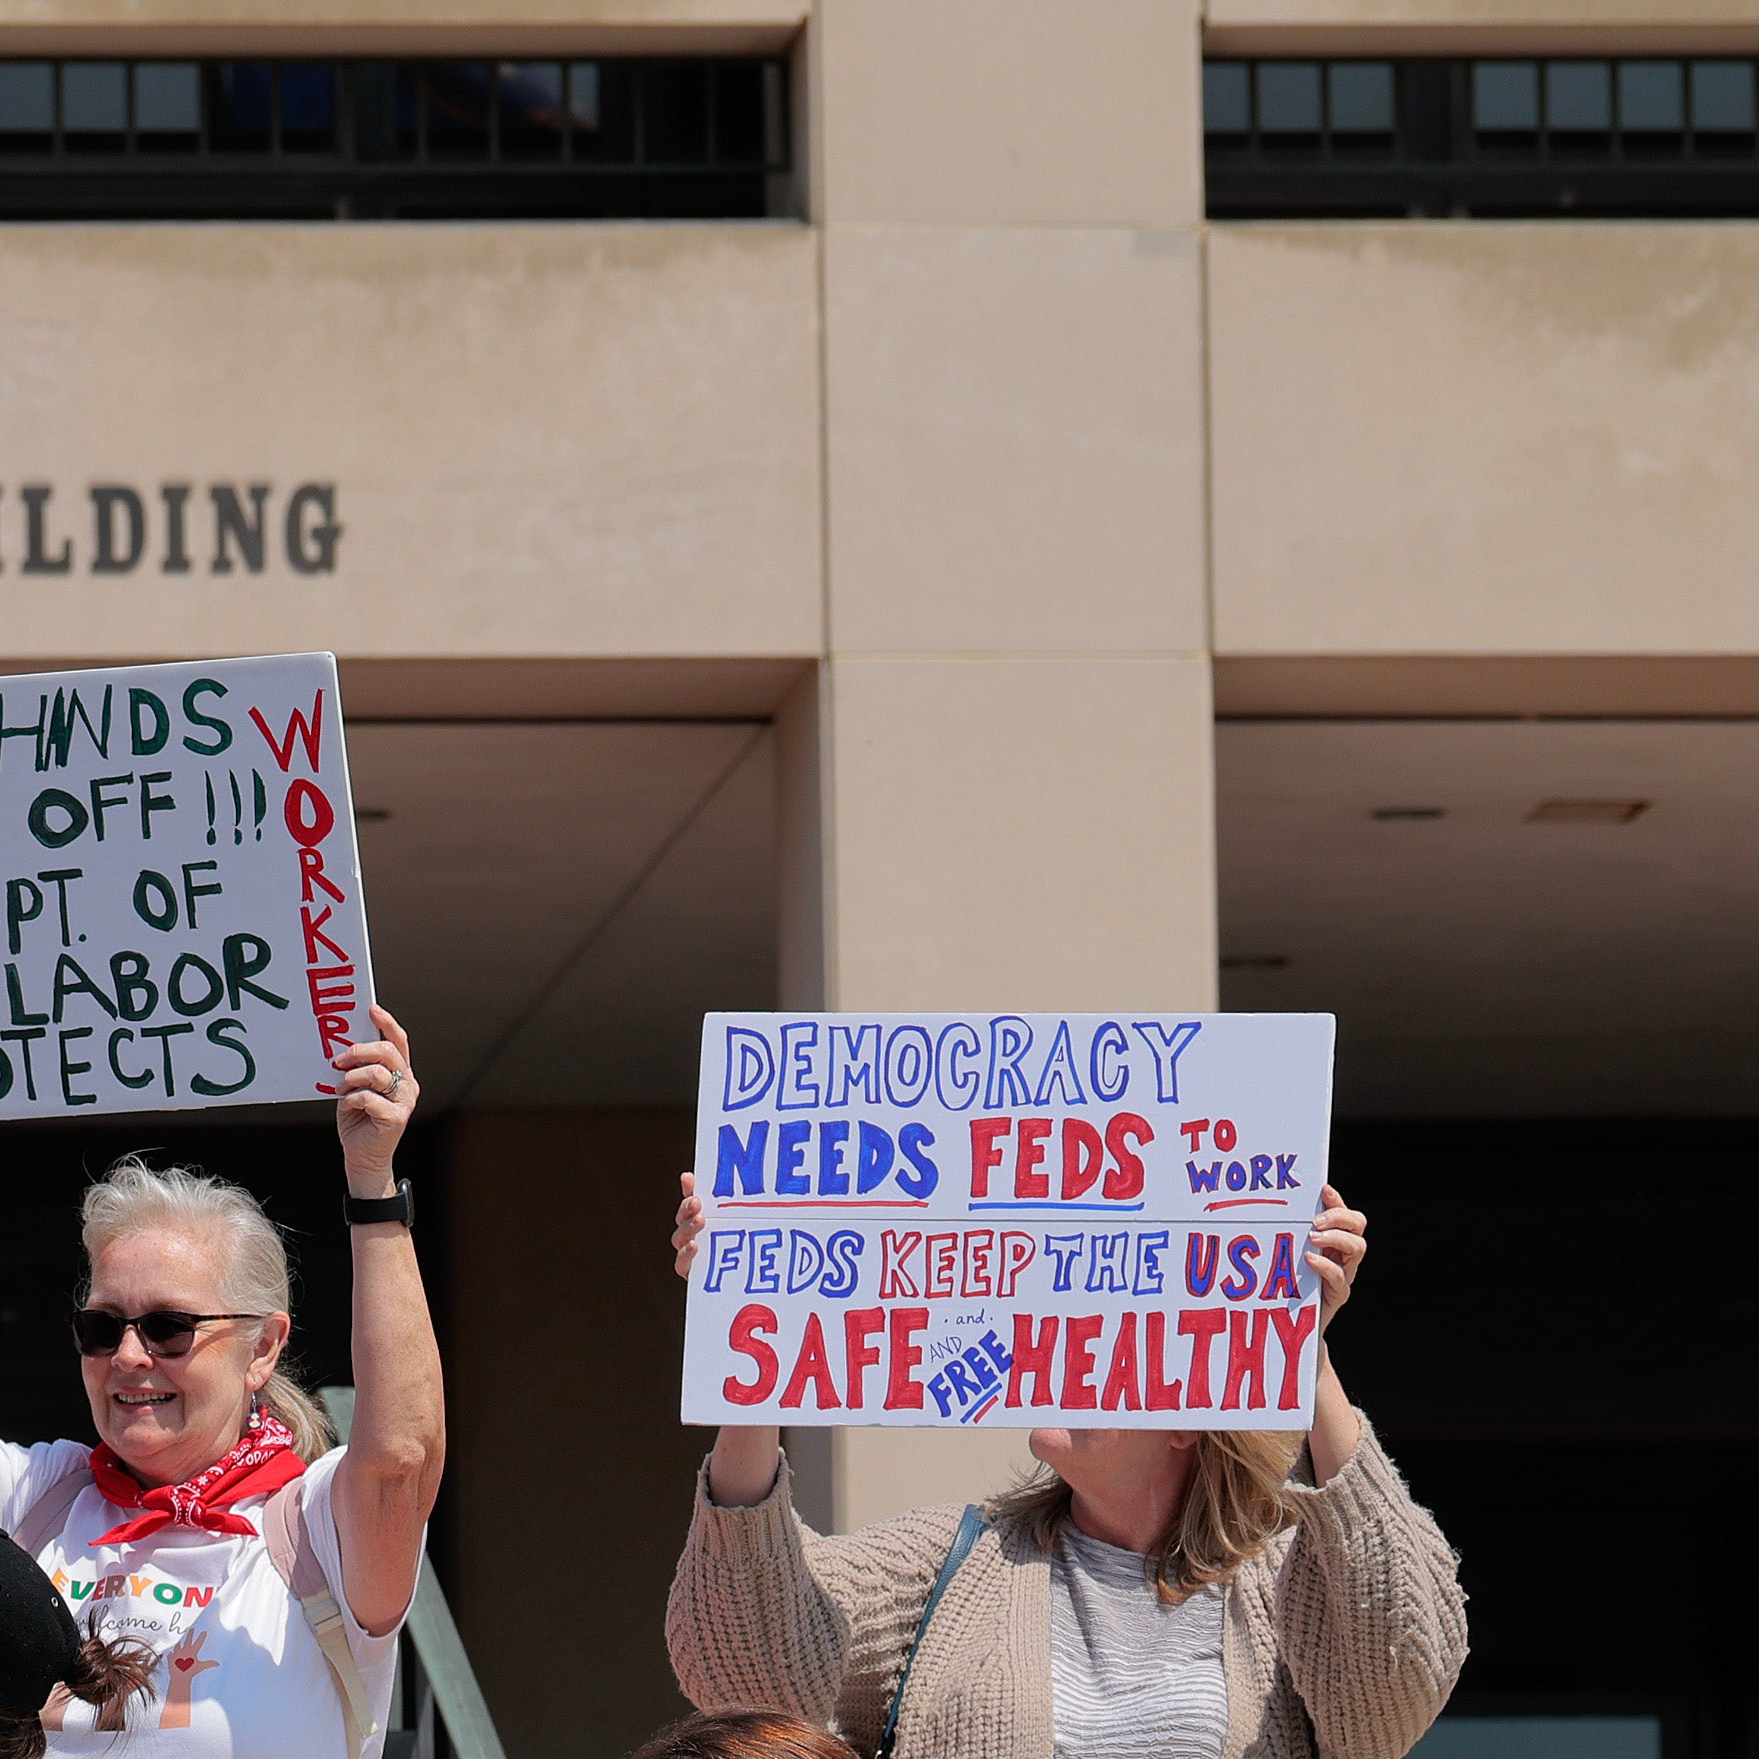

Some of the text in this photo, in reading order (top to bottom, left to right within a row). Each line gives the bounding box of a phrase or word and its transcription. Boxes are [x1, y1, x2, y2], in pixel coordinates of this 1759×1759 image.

[27, 771, 176, 848] OFF
[132, 860, 223, 932] OF
[3, 933, 290, 1026] LABOR
[722, 1015, 1202, 1111] DEMOCRACY
[712, 1111, 1237, 1201] NEEDS FEDS TO
[1186, 1152, 1302, 1195] WORK
[704, 1228, 1303, 1301] FEDS KEEP THE USA
[722, 1303, 929, 1412] SAFE
[926, 1328, 1015, 1418] FREE
[929, 1335, 963, 1363] AND
[1004, 1304, 1317, 1412] HEALTHY
[50, 1567, 215, 1608] EVERYON
